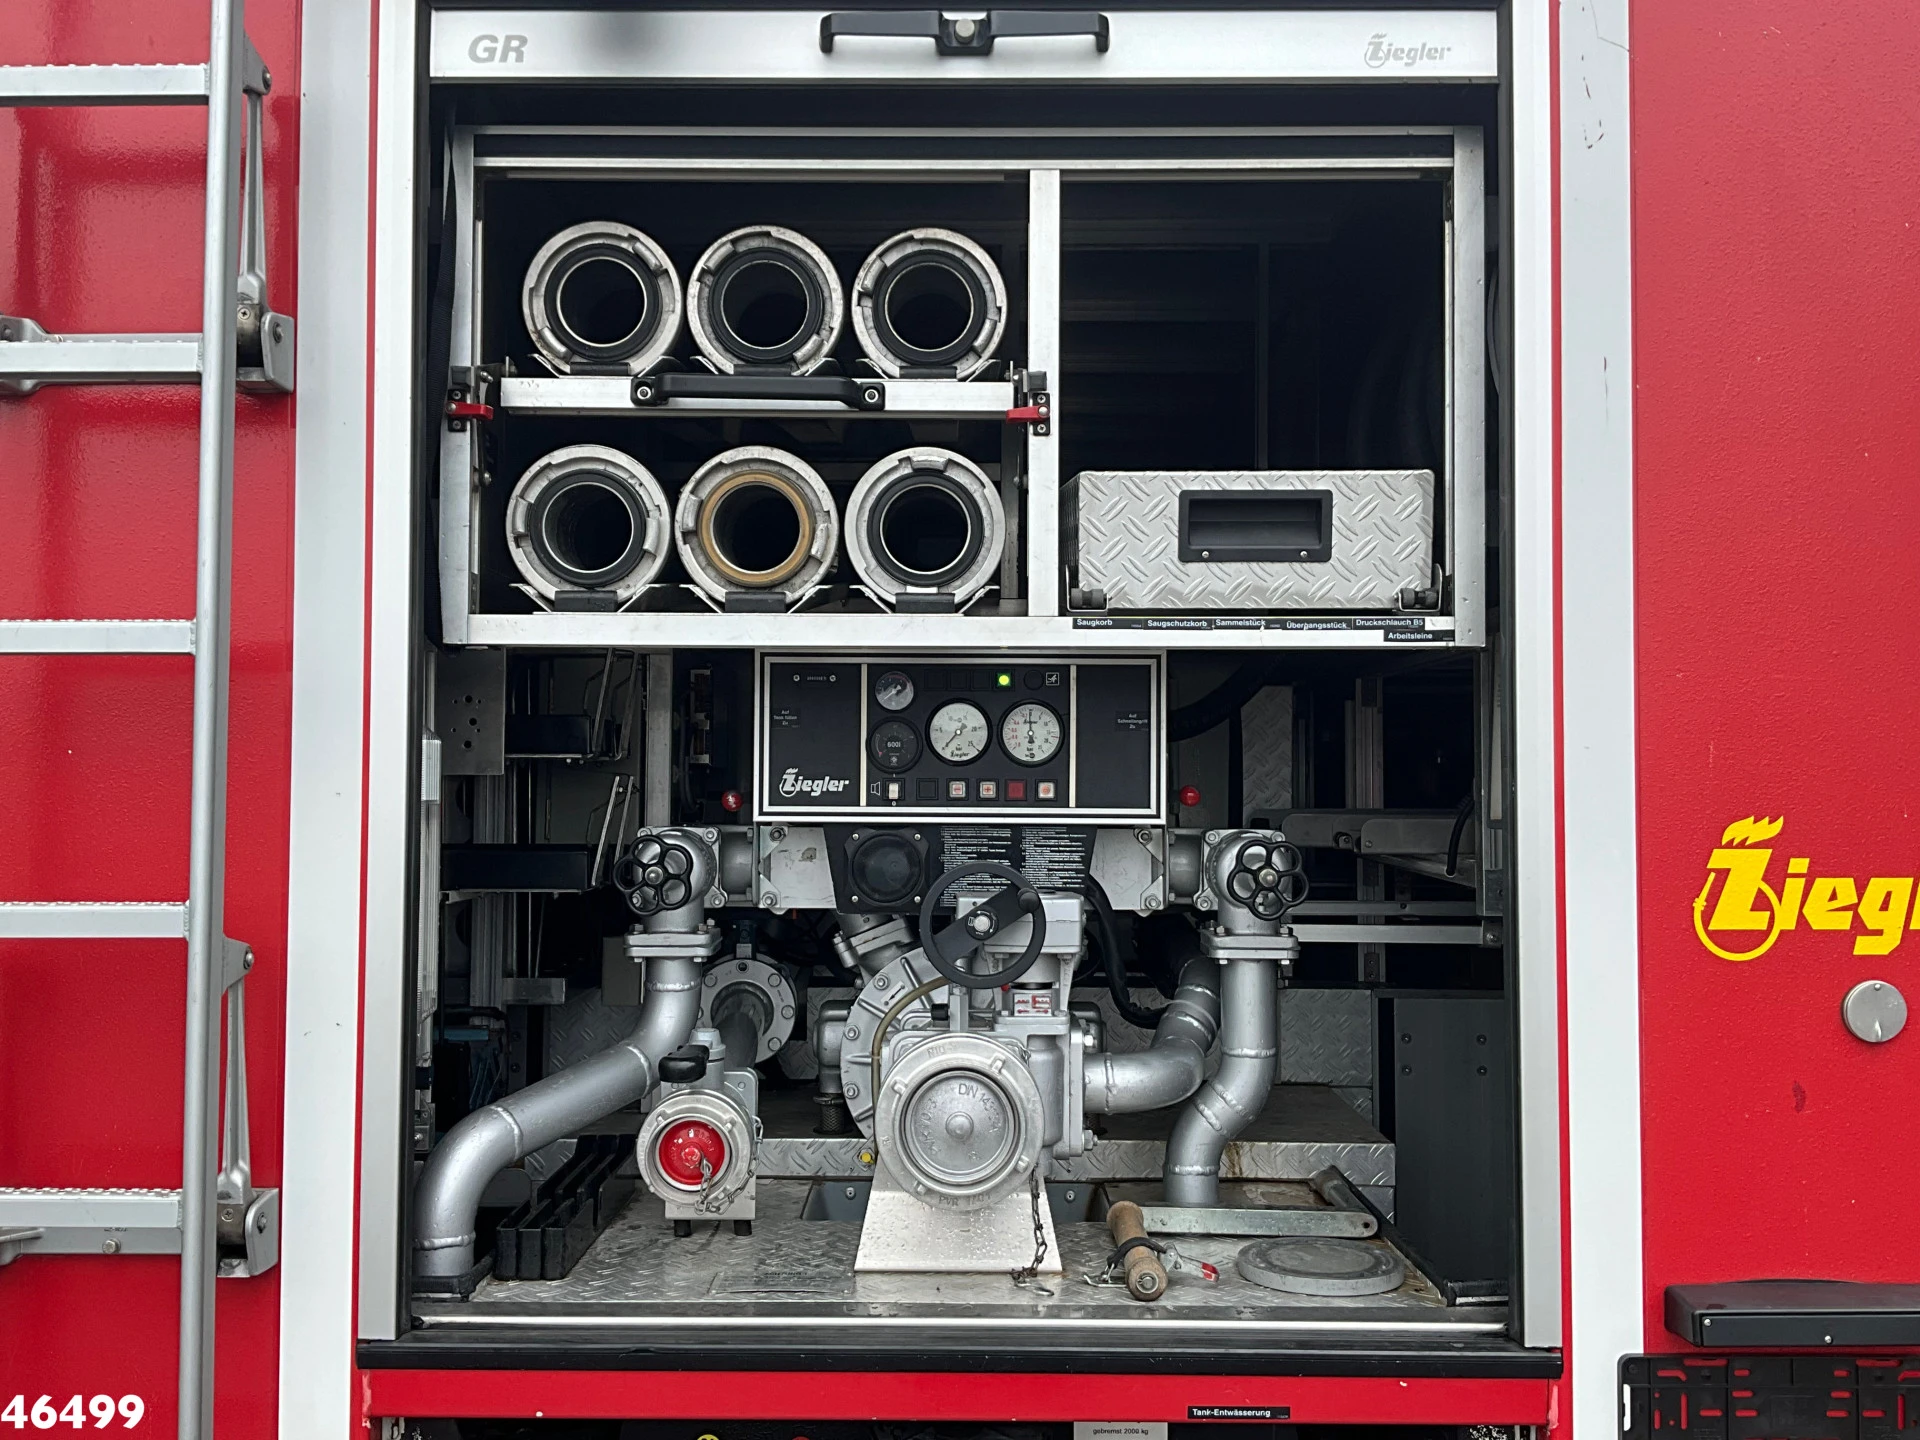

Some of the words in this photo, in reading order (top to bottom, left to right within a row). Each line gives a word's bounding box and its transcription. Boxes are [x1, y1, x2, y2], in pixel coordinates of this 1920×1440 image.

[467, 34, 529, 64] GR
[1364, 32, 1452, 68] Ziegler
[1076, 618, 1113, 627] Saugkorb
[1147, 619, 1207, 628] Saugschutzkorb
[1215, 618, 1266, 626] Sammelstück
[1286, 620, 1347, 629] Übergangsstück
[1355, 618, 1411, 626] Druckschlauch
[1387, 632, 1433, 640] Arbeitsleine
[779, 768, 850, 798] Ziegler
[1693, 815, 1920, 961] Zieg
[958, 1083, 978, 1098] DIN
[1192, 1408, 1271, 1418] Tank-Entwässerung
[1092, 1428, 1122, 1436] gebremst
[1141, 1428, 1149, 1436] kg
